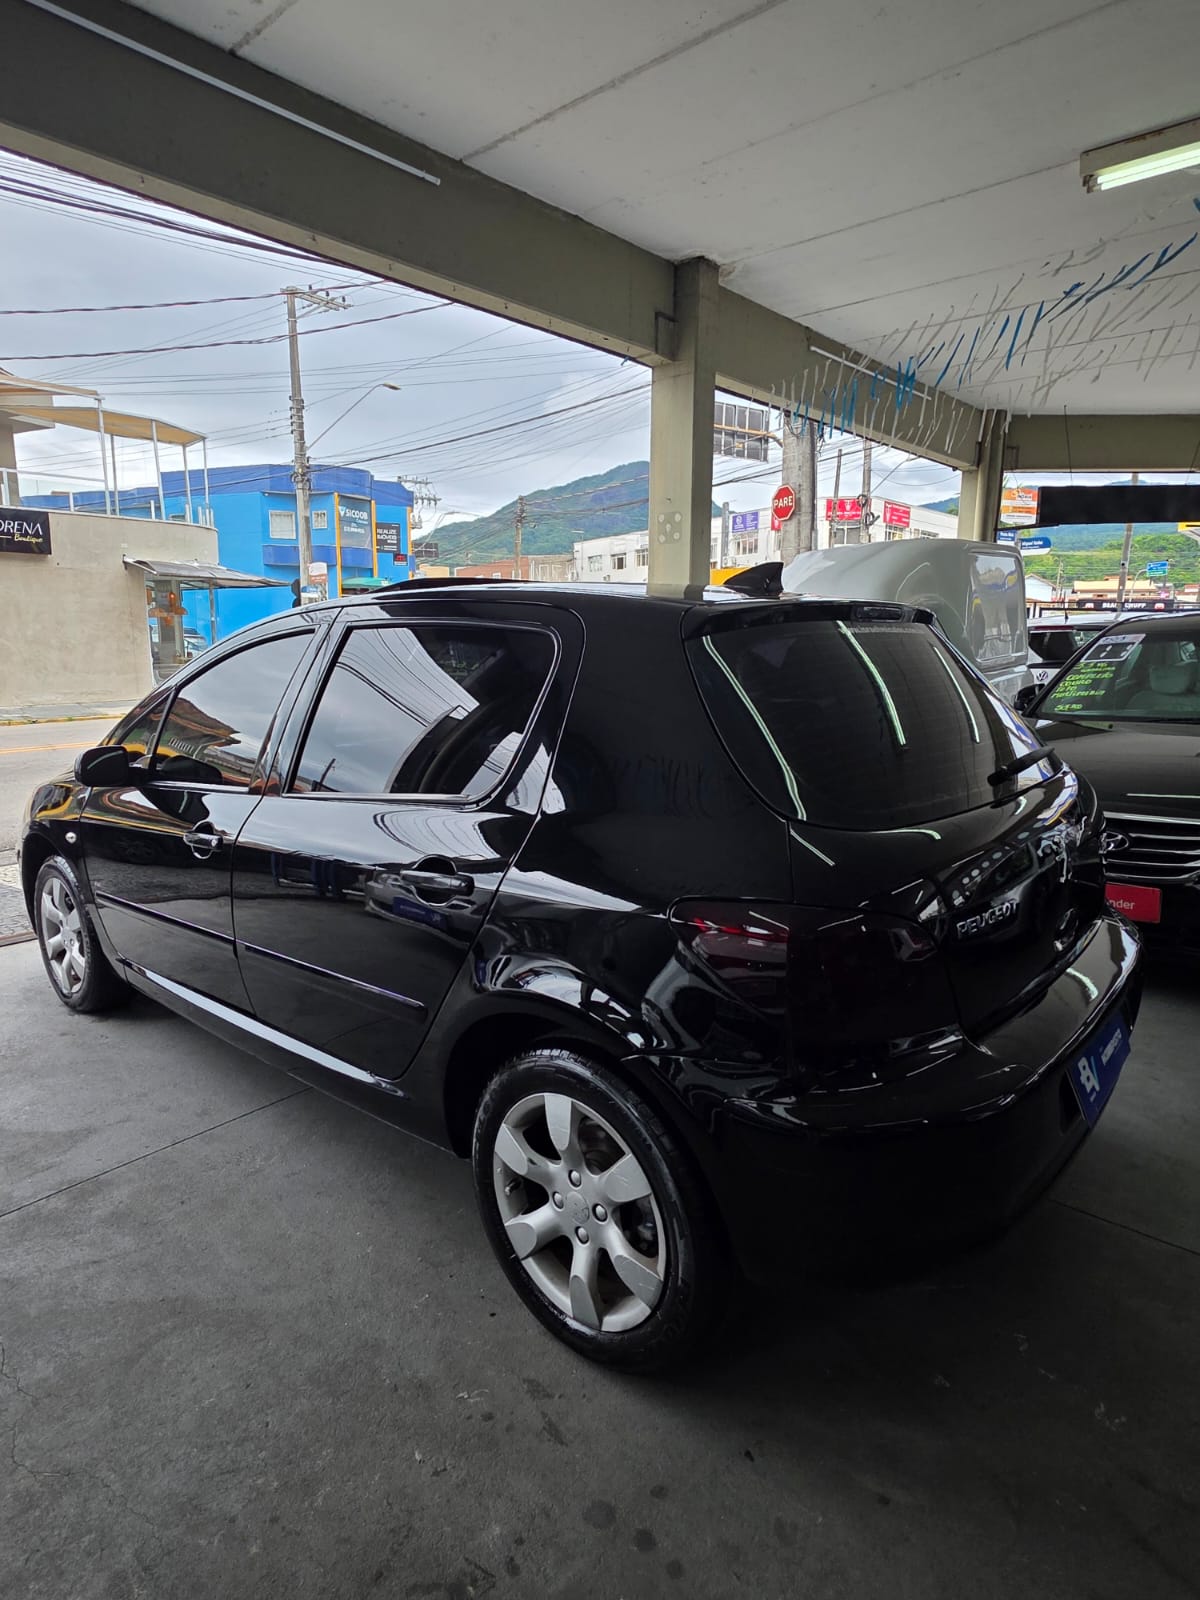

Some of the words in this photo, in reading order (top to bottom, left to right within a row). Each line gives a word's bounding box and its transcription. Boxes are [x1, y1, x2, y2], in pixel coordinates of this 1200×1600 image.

[773, 495, 793, 508] PARE
[345, 509, 368, 520] SICOOB
[1108, 898, 1136, 910] nder
[957, 898, 1020, 939] PEUGEOT
